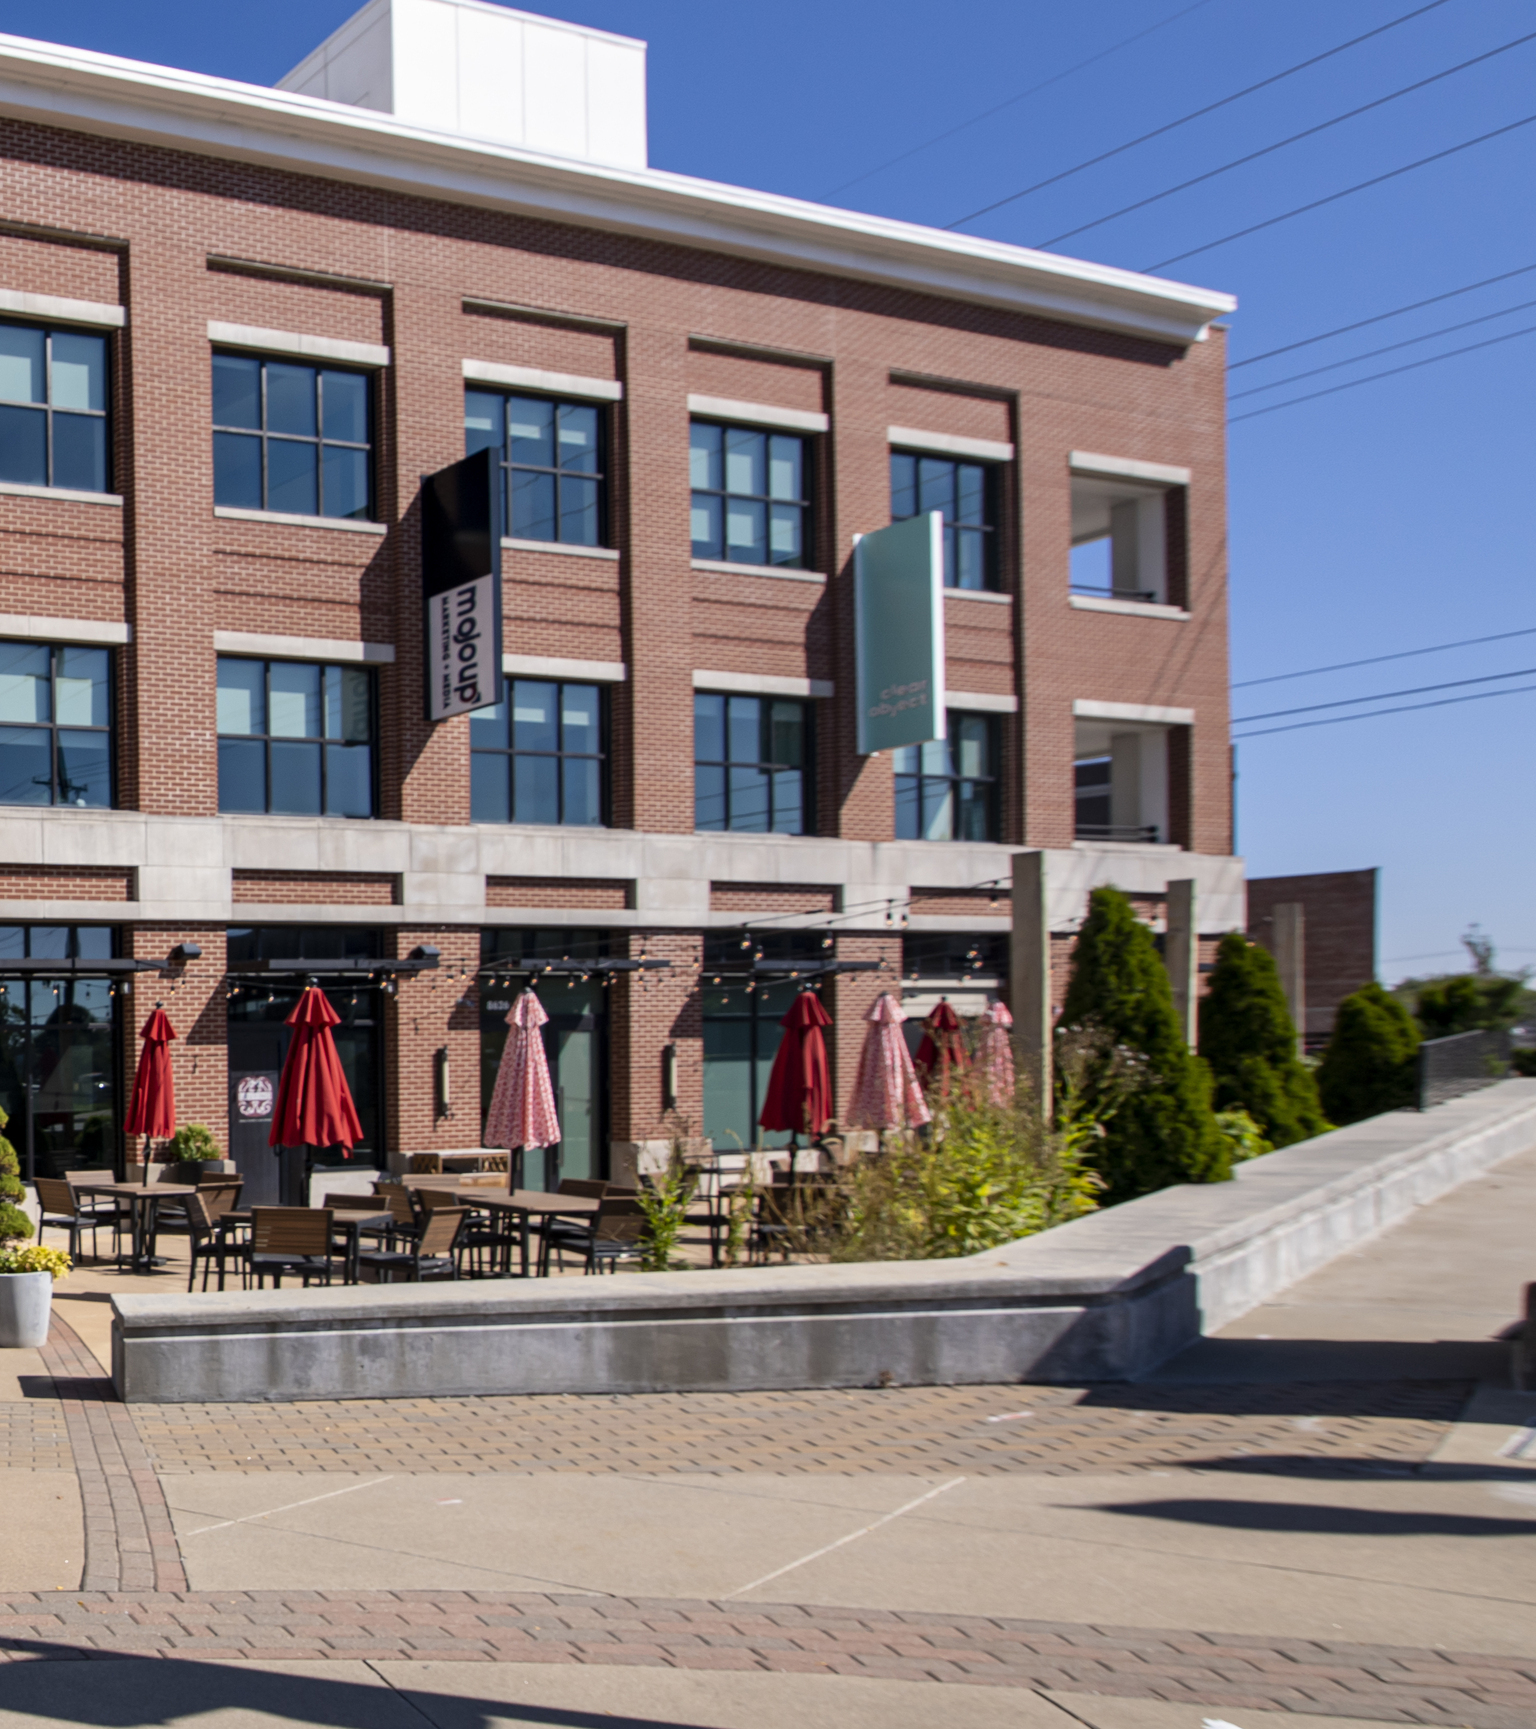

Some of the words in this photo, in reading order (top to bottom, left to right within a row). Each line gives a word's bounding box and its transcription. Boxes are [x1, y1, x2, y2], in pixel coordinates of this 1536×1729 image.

[442, 596, 451, 661] MARKETING
[453, 584, 481, 704] mojoup
[443, 673, 452, 710] MEDIA
